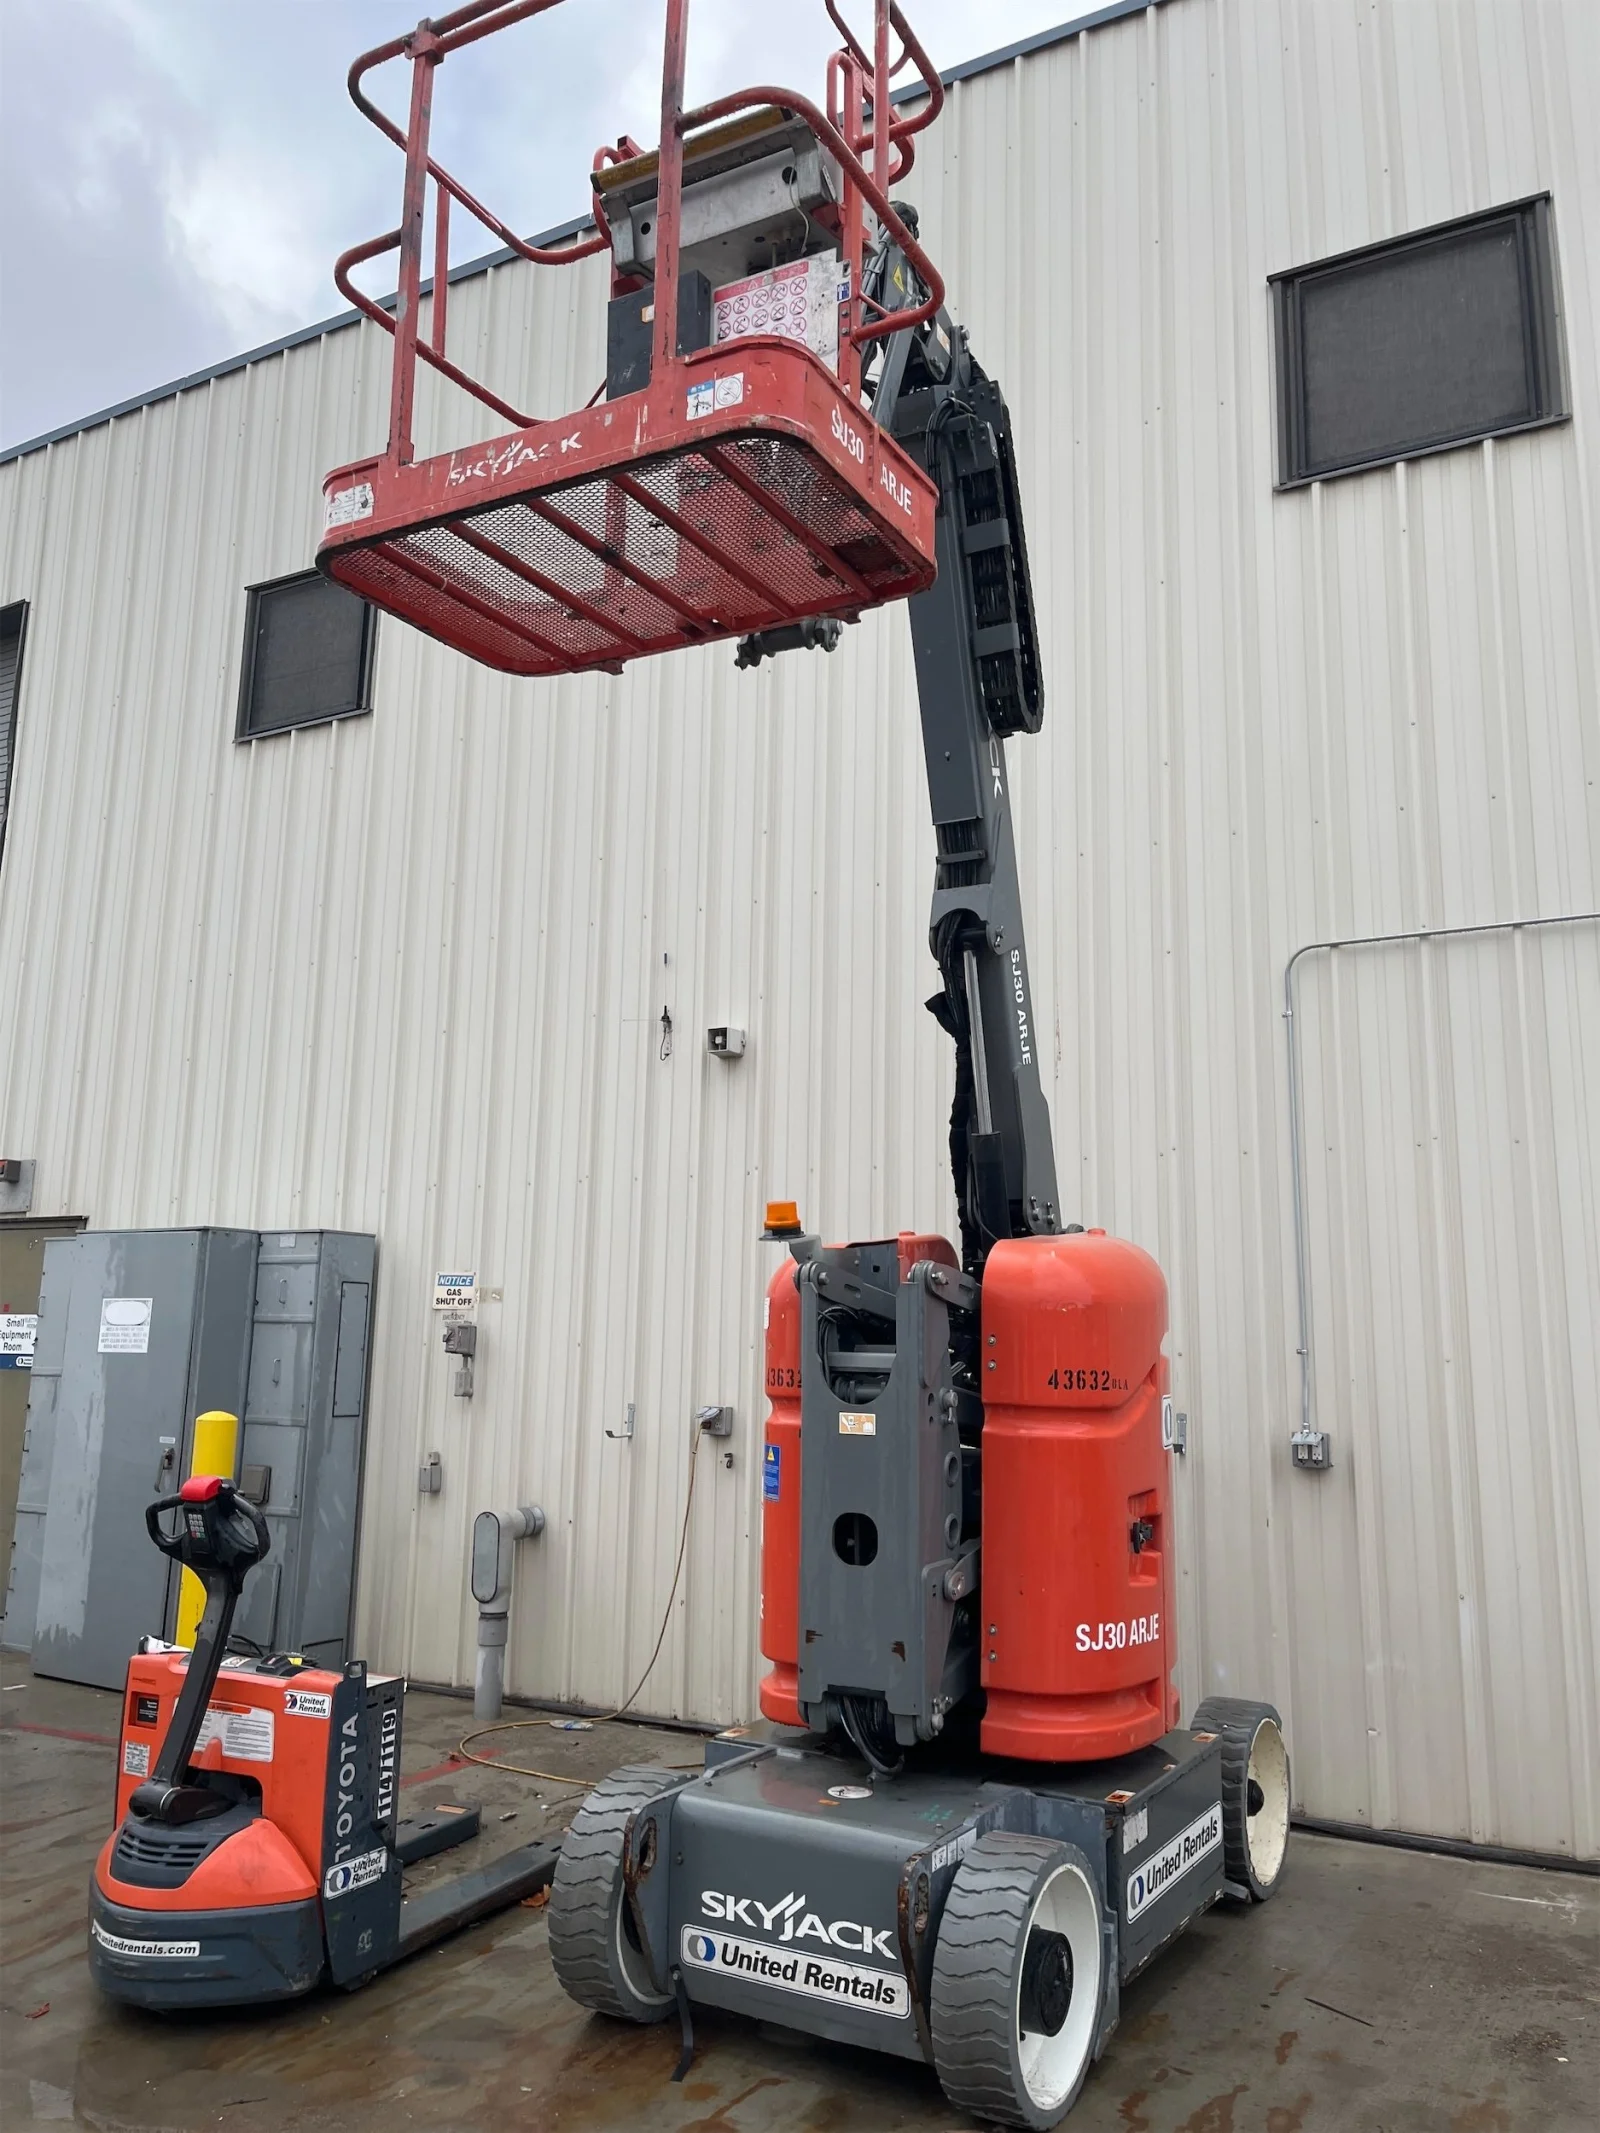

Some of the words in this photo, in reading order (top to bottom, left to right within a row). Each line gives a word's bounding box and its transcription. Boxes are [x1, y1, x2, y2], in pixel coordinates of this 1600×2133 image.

[831, 403, 865, 465] SJ30
[880, 463, 912, 516] ARJE
[1011, 949, 1024, 1004] SJ30
[1017, 1009, 1031, 1065] ARJE
[439, 1276, 472, 1286] NOTICE
[435, 1297, 456, 1306] SHUT
[457, 1298, 472, 1306] OFF
[446, 1288, 462, 1296] GAS
[6, 1318, 25, 1328] Small
[3, 1341, 22, 1352] Room
[1047, 1368, 1110, 1391] 43632
[1075, 1621, 1126, 1652] SJ30
[1128, 1612, 1159, 1647] ARJE
[298, 1703, 326, 1714] Rentals
[299, 1695, 326, 1706] United
[334, 1712, 359, 1863] TOYOTA
[352, 1854, 382, 1873] United
[1147, 1842, 1181, 1895] United
[1183, 1816, 1218, 1863] Rentals
[351, 1866, 384, 1885] Rentals
[701, 1890, 897, 1960] SKYJACK
[721, 1943, 798, 1981] United
[803, 1962, 896, 2005] Rentals
